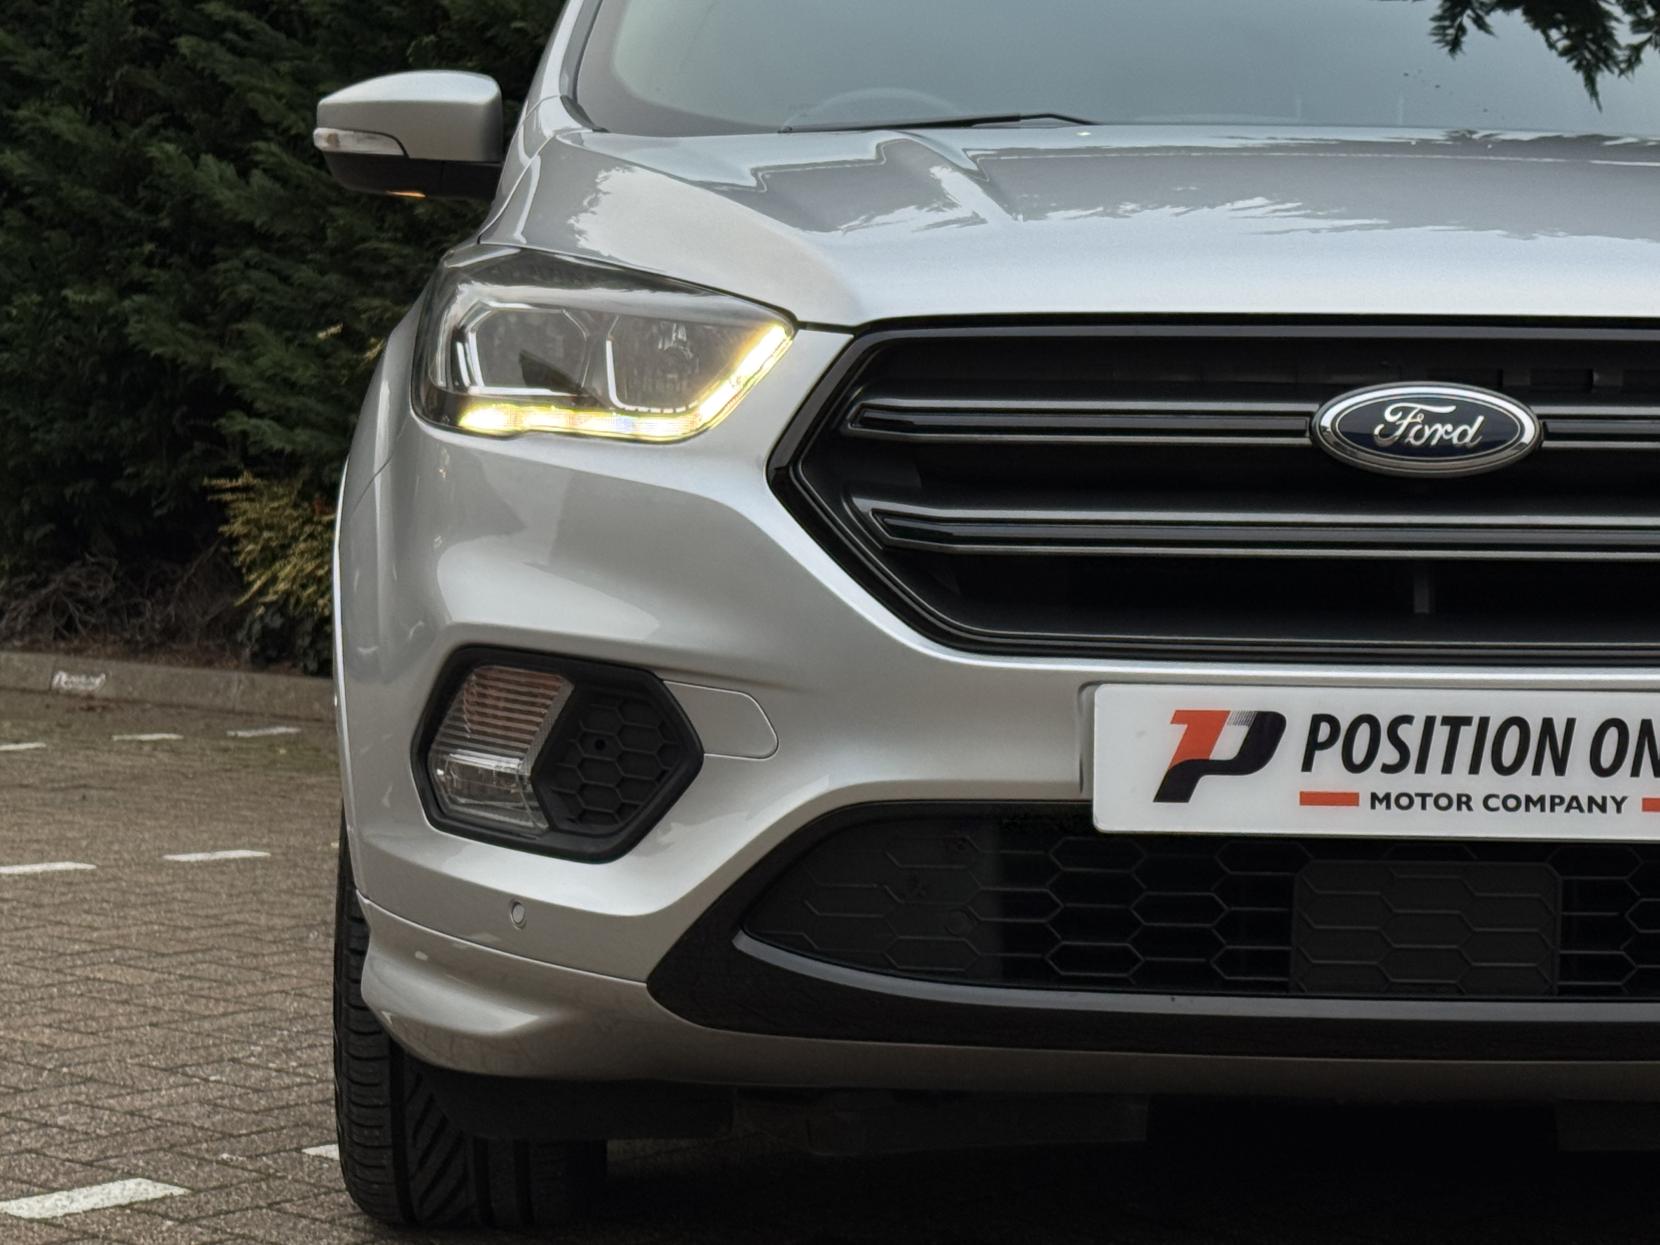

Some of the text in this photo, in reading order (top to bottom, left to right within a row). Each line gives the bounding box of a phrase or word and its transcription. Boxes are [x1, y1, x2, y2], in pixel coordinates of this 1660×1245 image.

[1373, 402, 1485, 447] Ford
[1300, 713, 1577, 777] POSITION
[1370, 791, 1629, 814] MOTOR COMPANY
